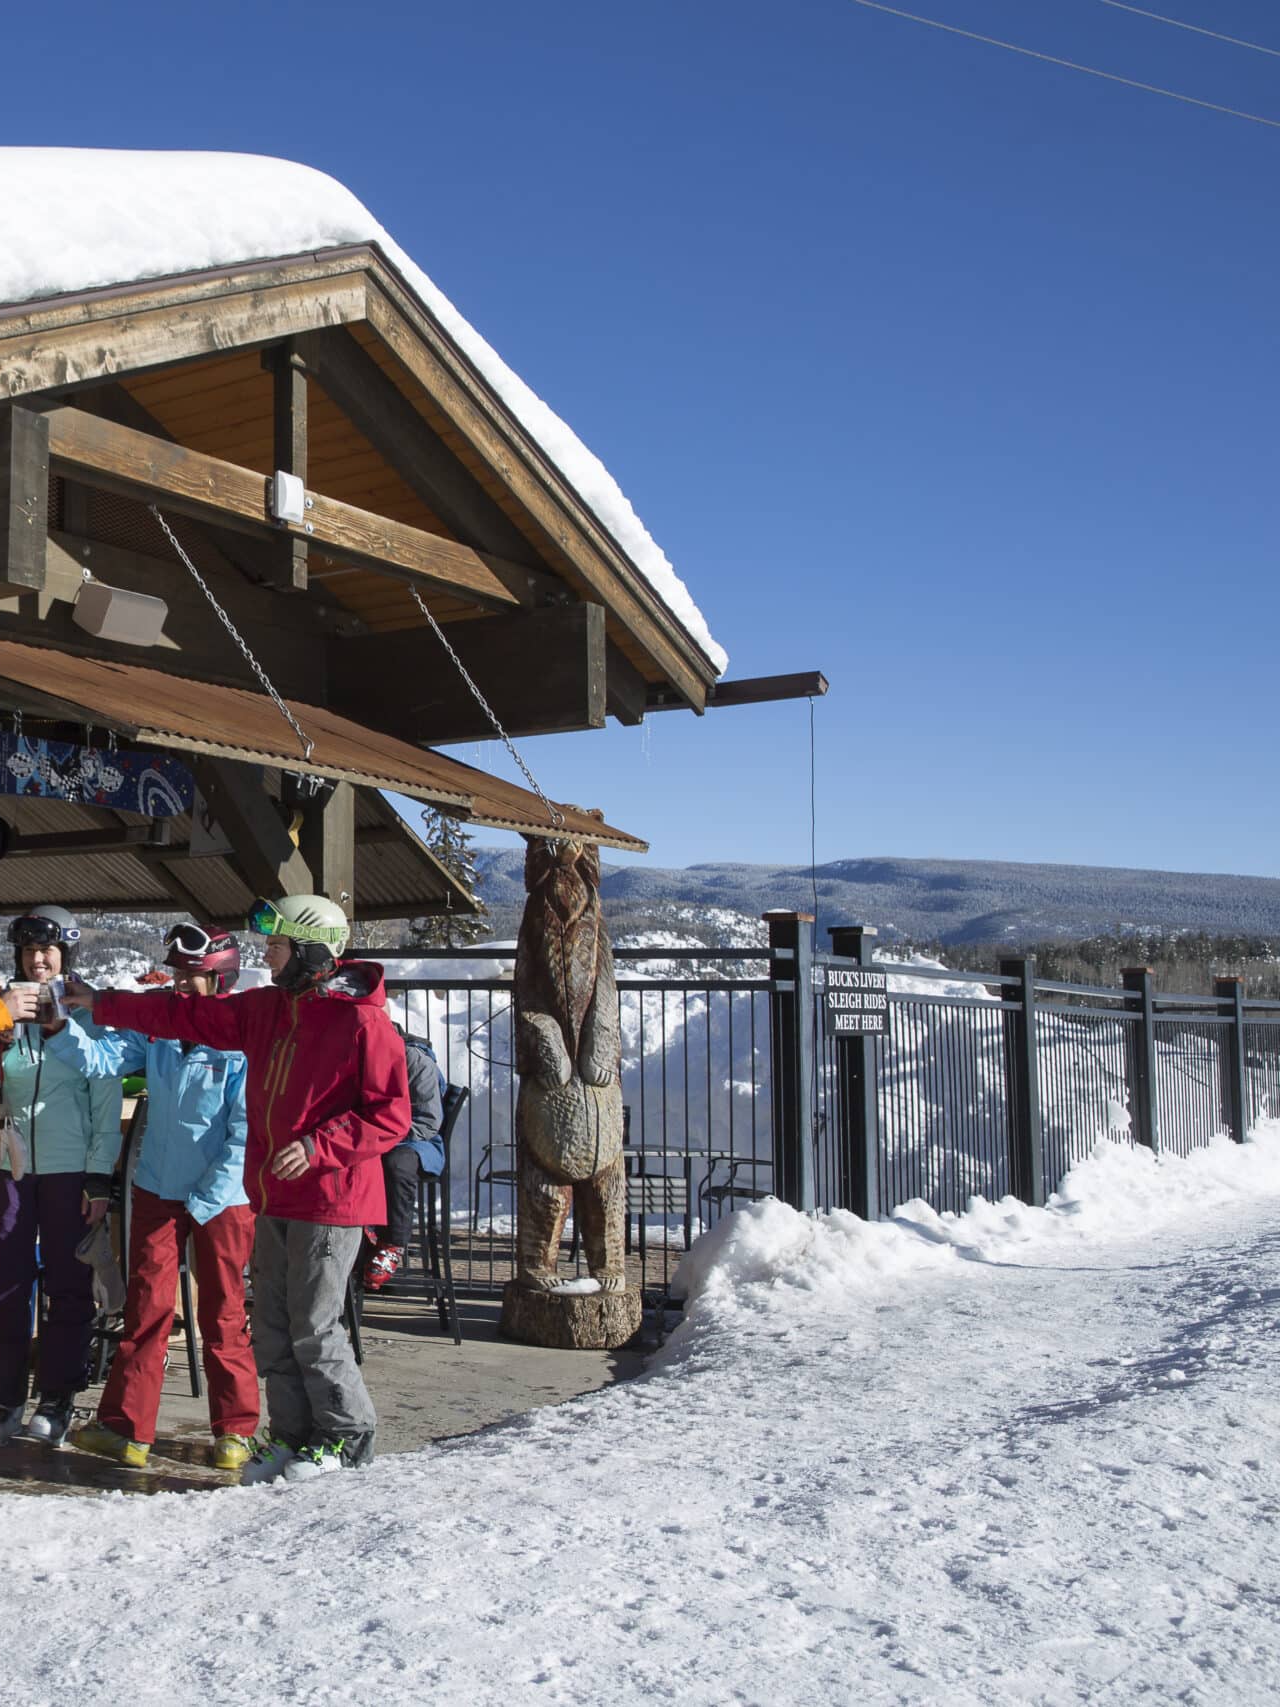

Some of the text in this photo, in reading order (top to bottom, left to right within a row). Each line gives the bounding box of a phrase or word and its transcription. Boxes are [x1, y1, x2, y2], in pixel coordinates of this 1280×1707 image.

[828, 970, 886, 988] BUCK'S LIVERY
[828, 992, 887, 1010] SLEIGH RIDES
[835, 1014, 884, 1030] MEET HERE
